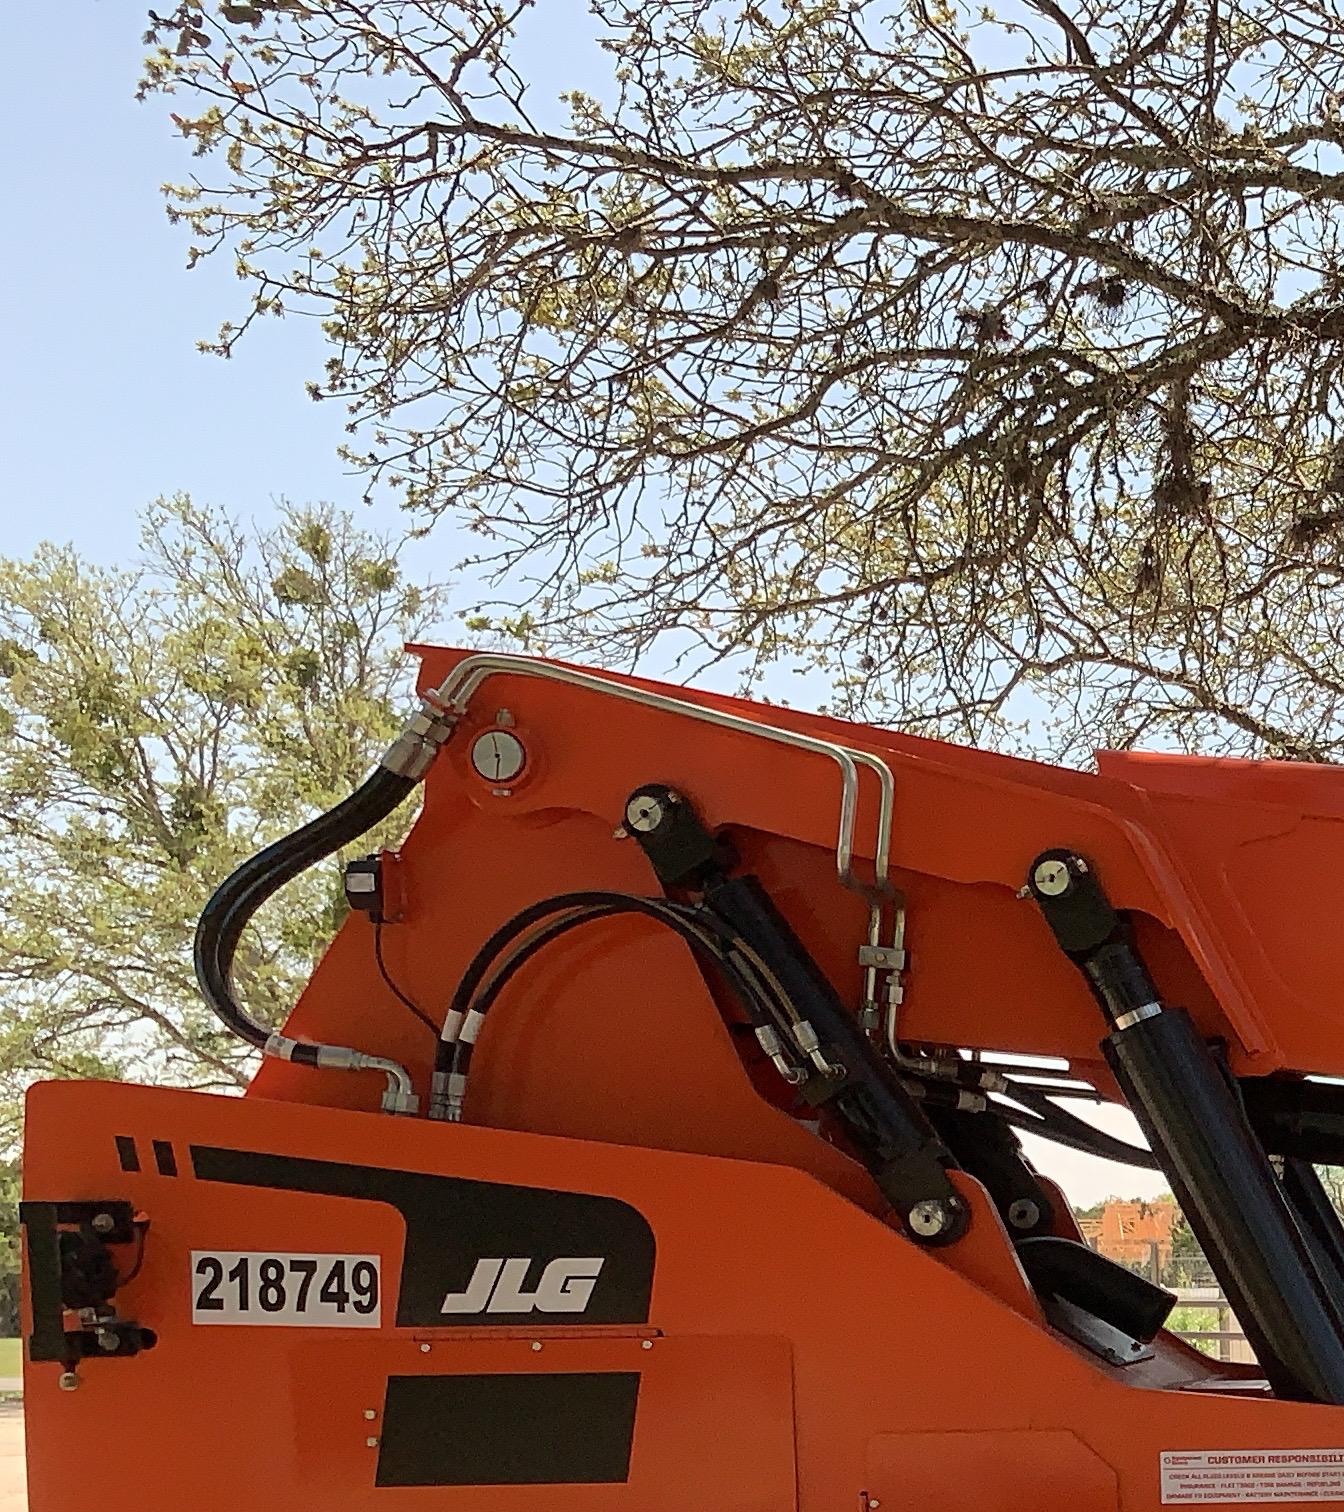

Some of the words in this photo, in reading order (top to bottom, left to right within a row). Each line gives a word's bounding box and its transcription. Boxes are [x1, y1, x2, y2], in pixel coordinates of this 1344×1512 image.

[195, 1256, 379, 1314] 218749
[441, 1257, 605, 1315] JLG
[1207, 1455, 1265, 1465] CUSTOMER
